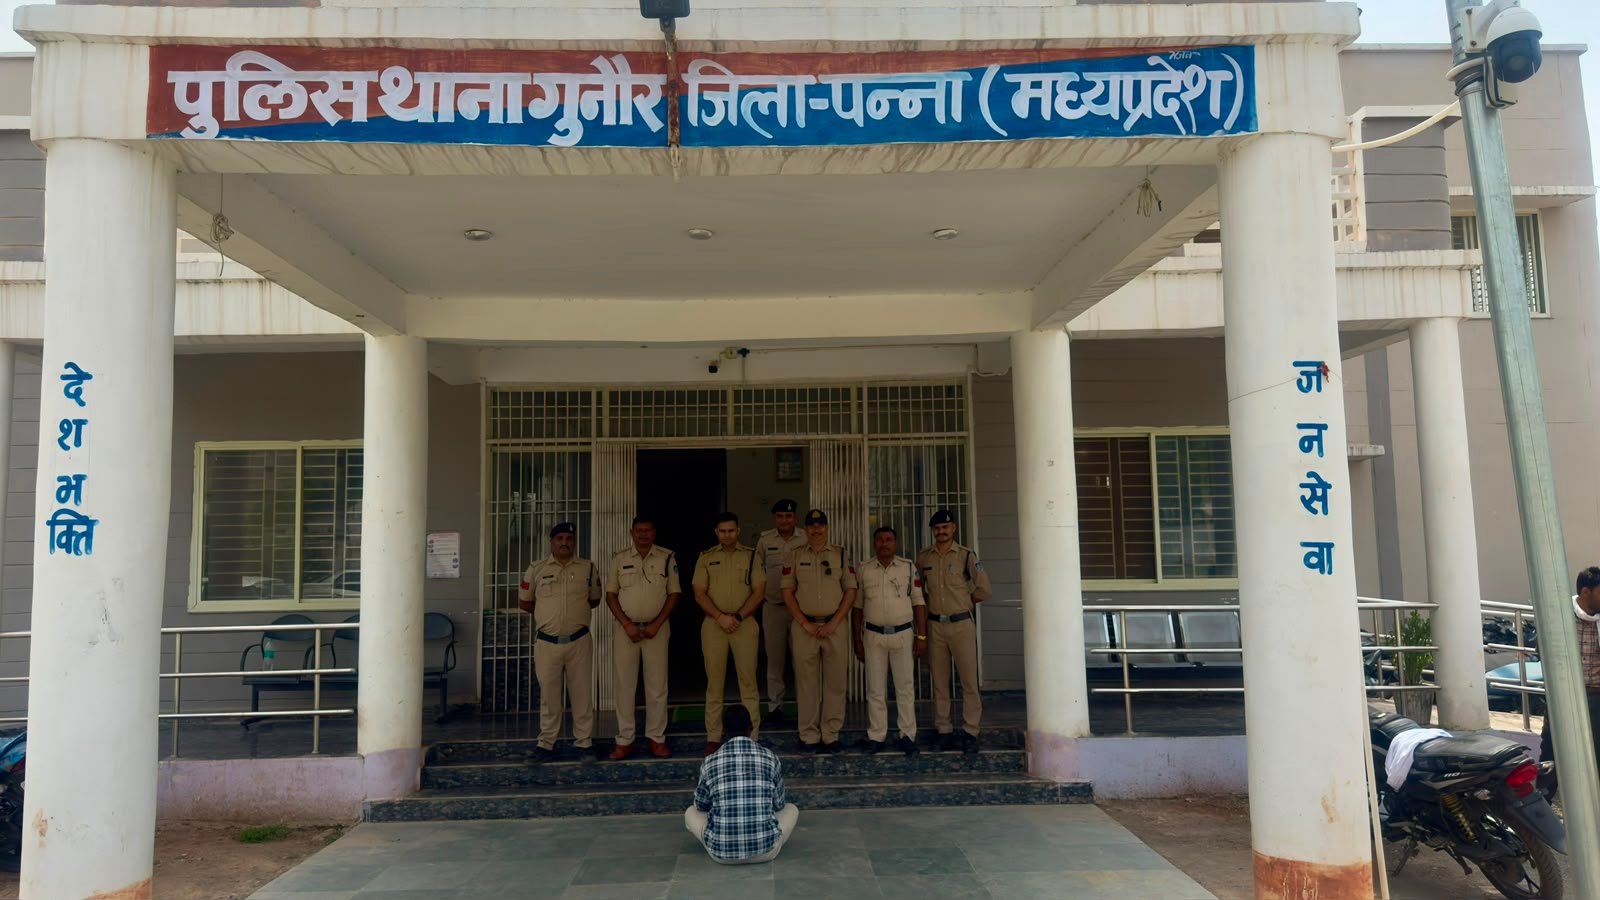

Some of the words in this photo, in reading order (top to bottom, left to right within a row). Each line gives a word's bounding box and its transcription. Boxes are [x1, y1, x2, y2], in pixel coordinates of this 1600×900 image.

[167, 49, 379, 140] पुलिस
[378, 65, 532, 126] थाना
[531, 53, 668, 147] गुनौर
